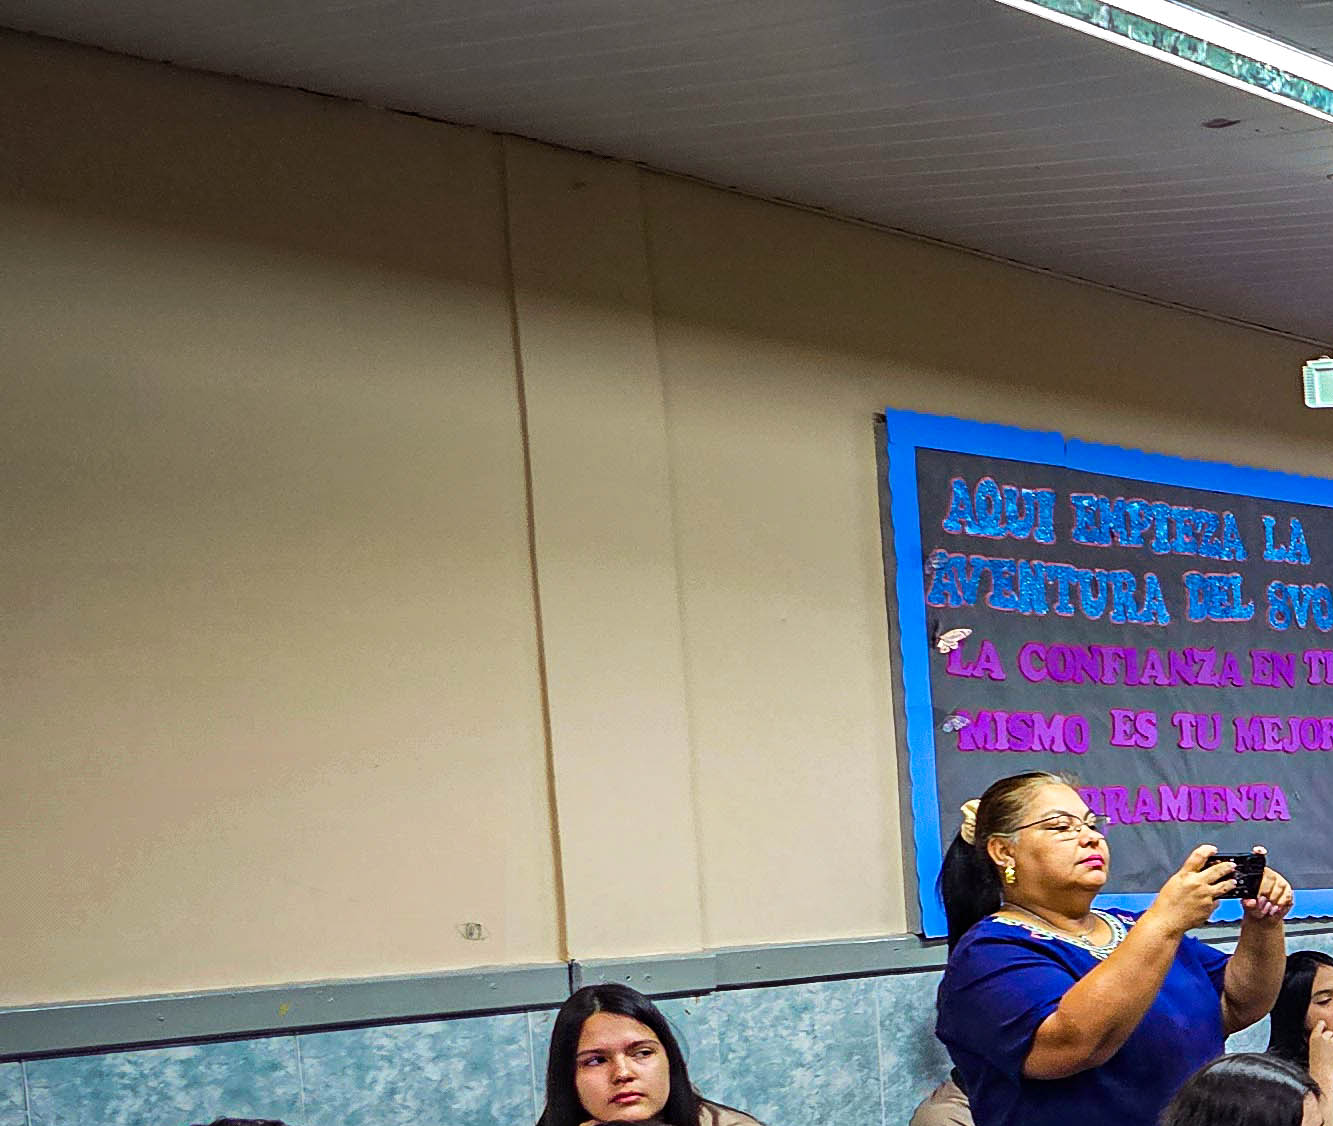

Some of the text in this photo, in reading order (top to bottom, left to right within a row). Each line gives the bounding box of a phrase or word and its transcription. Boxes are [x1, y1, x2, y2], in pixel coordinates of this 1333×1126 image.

[942, 477, 1312, 565] AQUI EMPIEZA LA
[926, 549, 1171, 626] AVENTURA
[1182, 570, 1254, 622] DEL
[946, 639, 1006, 681] LA
[1018, 641, 1244, 687] CONFIANZA
[1250, 650, 1296, 687] EN
[955, 709, 1089, 755] MISMO
[1109, 708, 1158, 749] ES
[1172, 711, 1222, 750] TU
